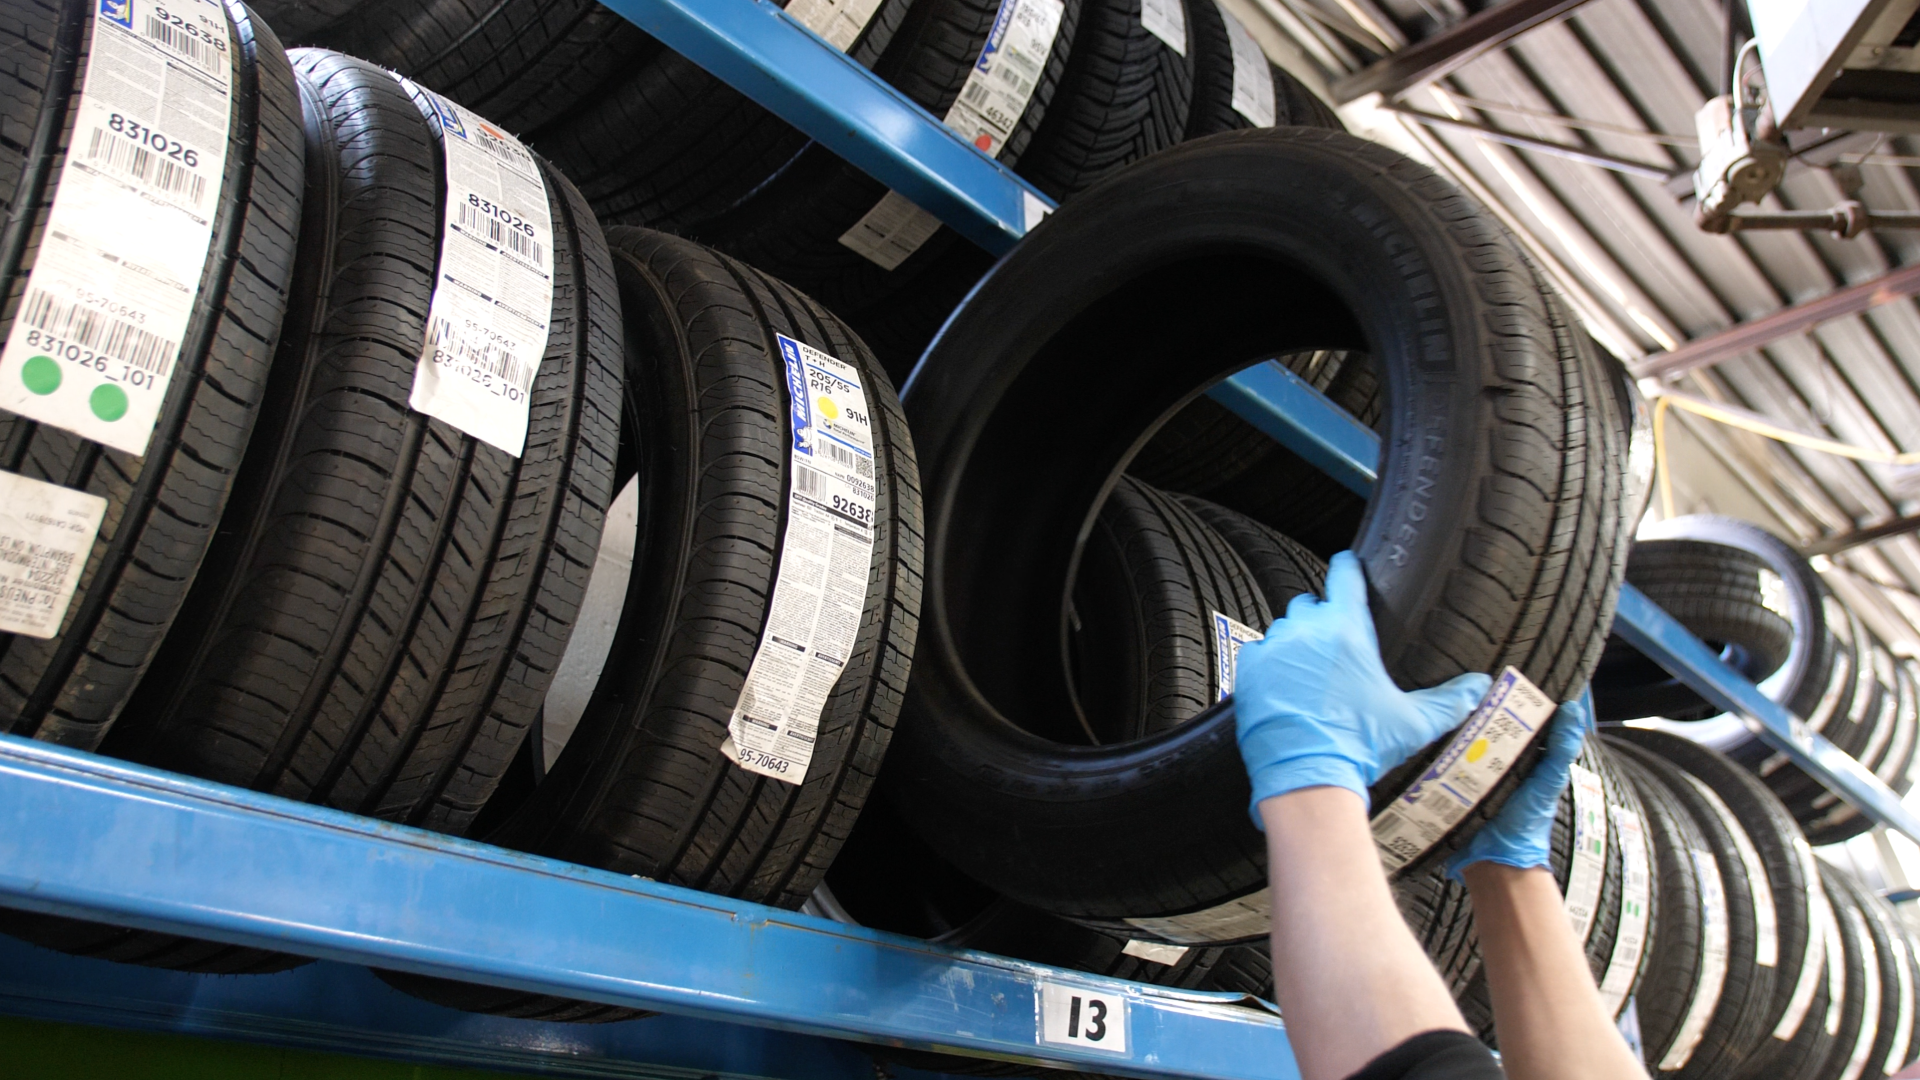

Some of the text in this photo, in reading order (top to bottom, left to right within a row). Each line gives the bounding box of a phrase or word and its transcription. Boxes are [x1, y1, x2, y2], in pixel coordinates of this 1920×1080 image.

[155, 7, 227, 52] 92638
[198, 14, 225, 34] 91H
[108, 113, 199, 168] 831026
[468, 193, 535, 237] 831026
[76, 287, 147, 324] 95-70643
[465, 320, 516, 350] 95-70643
[26, 329, 156, 391] 831026_101
[802, 346, 847, 370] DEFENDER
[433, 350, 525, 405] 831026_101
[784, 342, 807, 422] MICHELIN
[809, 369, 851, 393] 205/55
[811, 380, 832, 394] R16
[833, 423, 856, 436] MICHELIN
[846, 408, 868, 426] 91H
[846, 474, 875, 492] 0092638
[852, 488, 875, 502] 831026
[833, 494, 874, 523] 92638
[1218, 620, 1231, 695] MICHELIN
[738, 747, 790, 774] 95-70643
[1068, 995, 1107, 1041] 13
